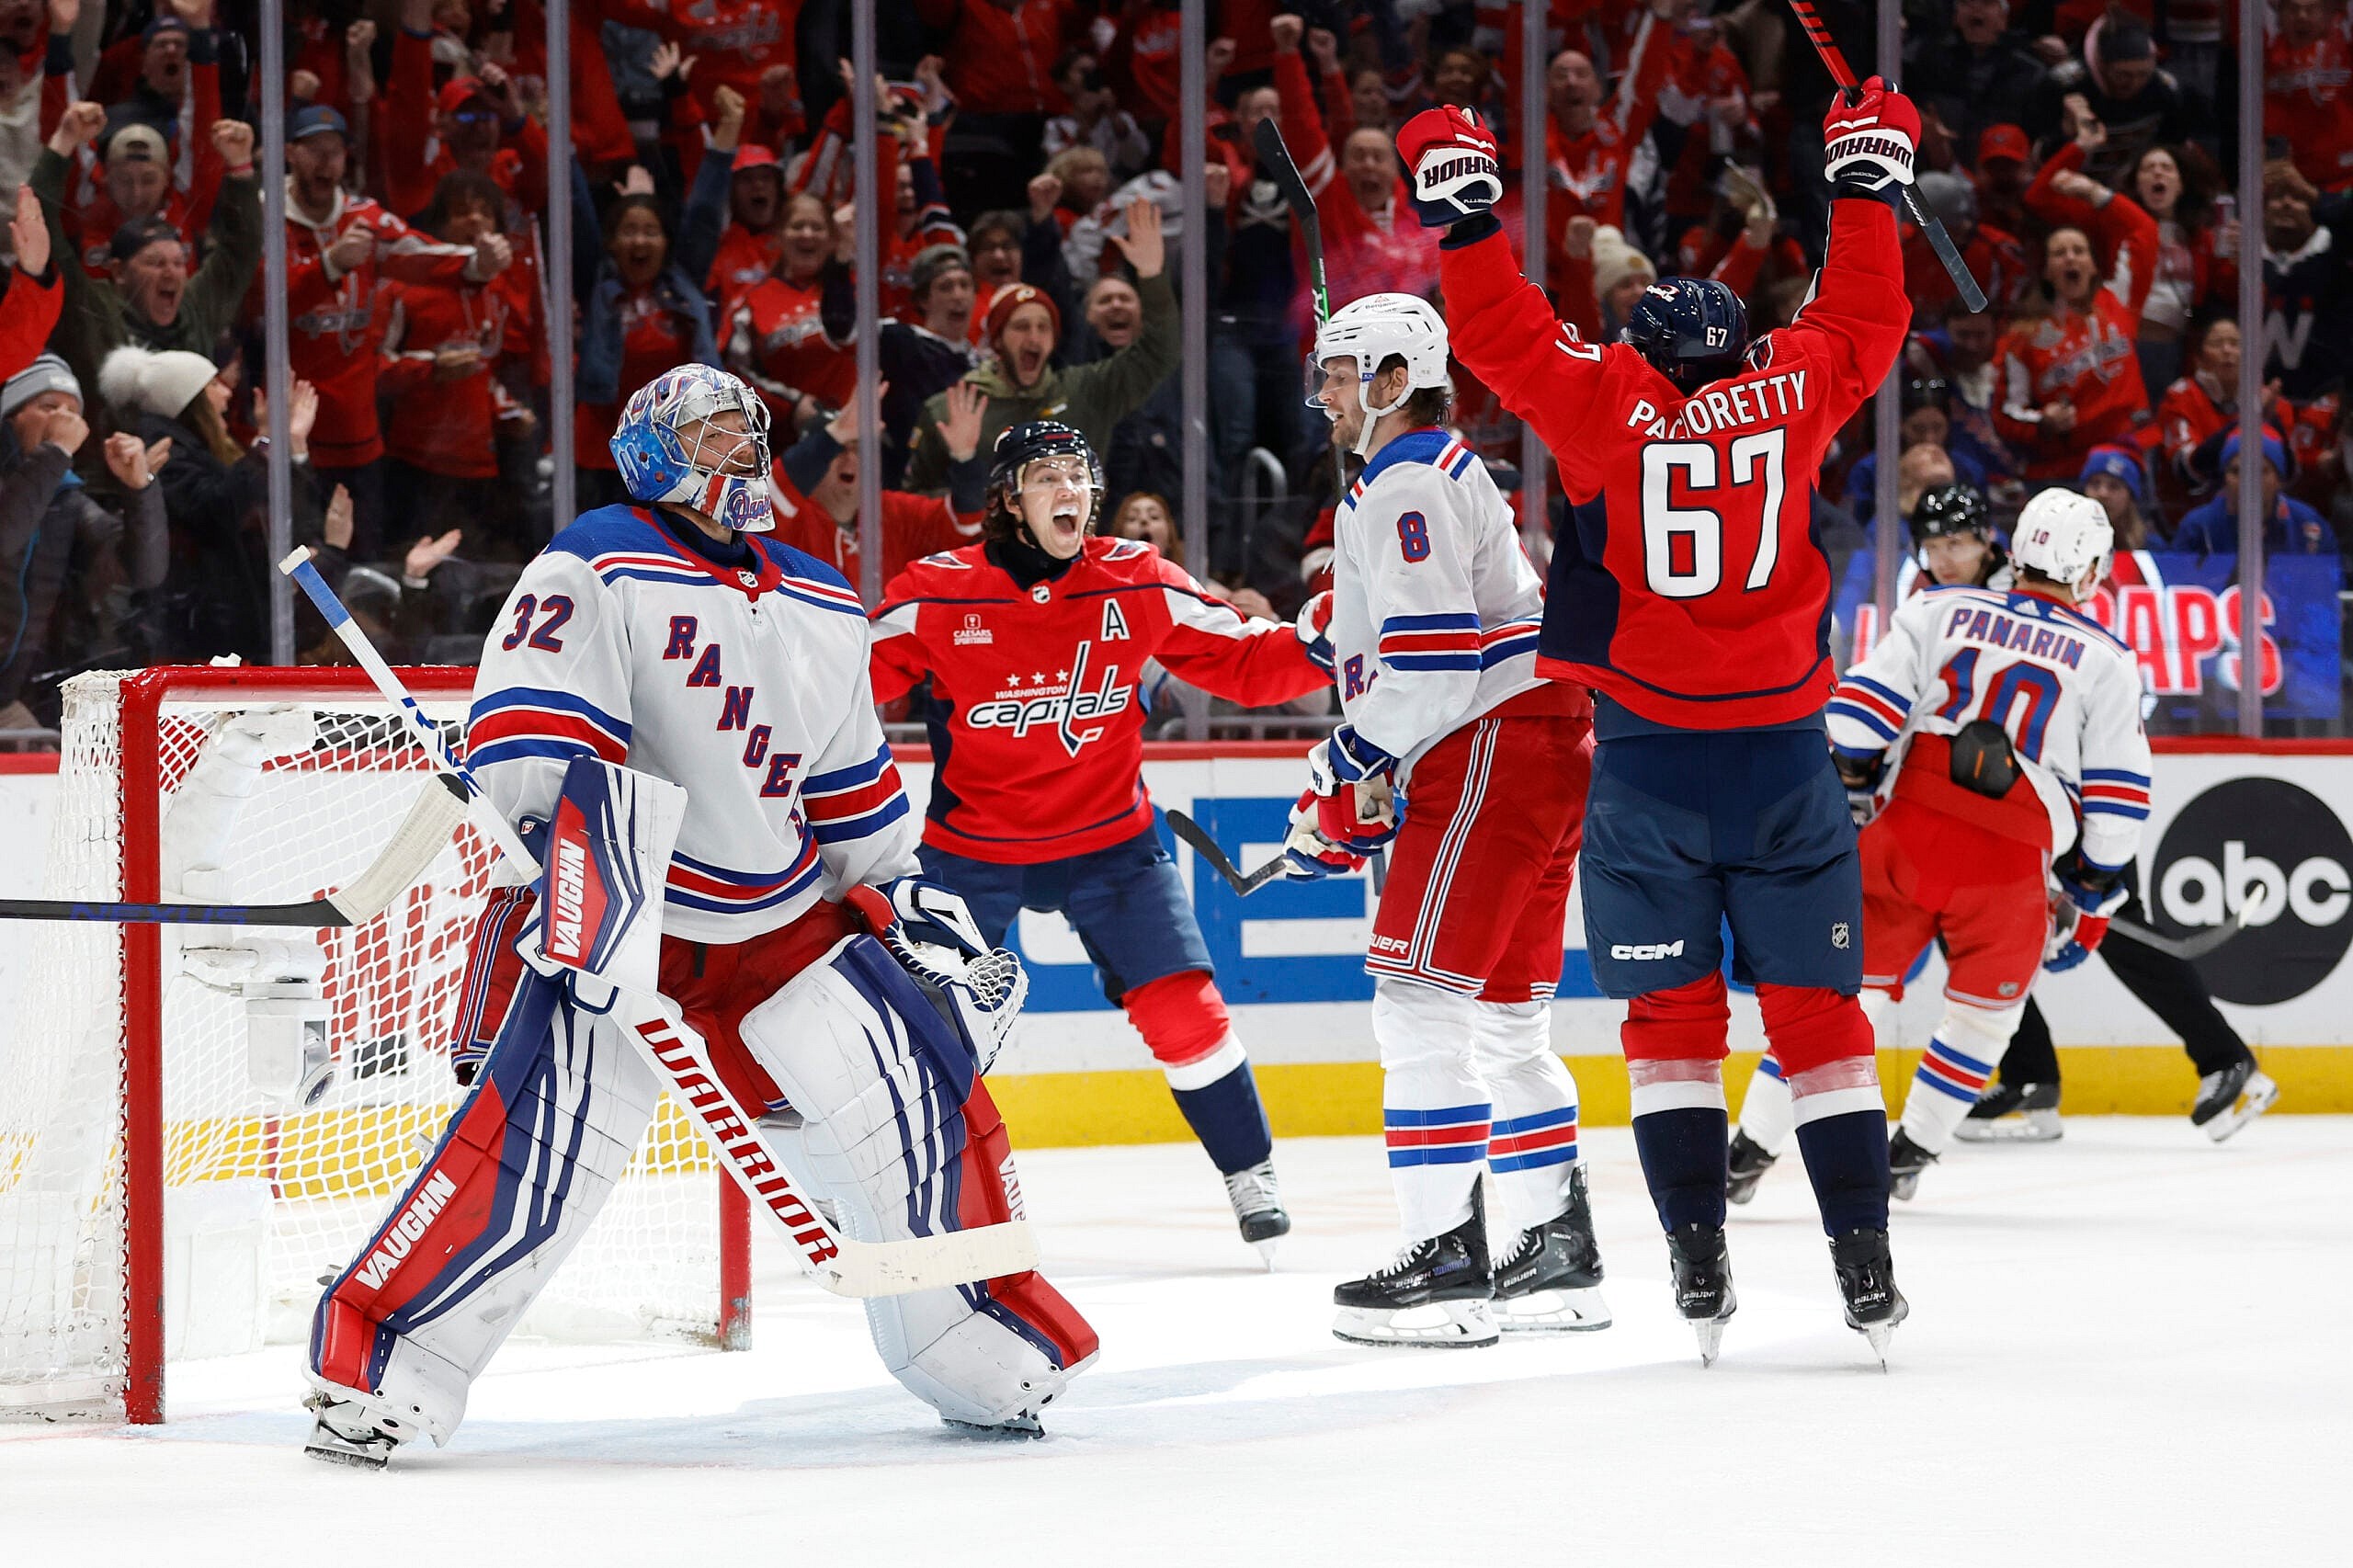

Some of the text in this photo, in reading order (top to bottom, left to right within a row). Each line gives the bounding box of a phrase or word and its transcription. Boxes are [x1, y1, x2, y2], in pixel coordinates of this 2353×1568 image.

[1423, 155, 1499, 189] RRIOR
[1825, 136, 1913, 170] WARRIO
[1706, 326, 1728, 347] 67
[1396, 510, 1431, 563] 8
[1641, 425, 1788, 600] 67
[2031, 528, 2050, 545] 10
[502, 593, 574, 653] 32
[953, 629, 993, 638] CAESARS
[1101, 597, 1131, 642] A
[1946, 608, 2086, 671] PANARIN
[995, 686, 1067, 699] WASHINGTON
[1934, 646, 2063, 764] 10
[553, 838, 585, 959] VAUGHN
[2161, 840, 2352, 927] abc
[69, 903, 248, 925] NEXUS
[1370, 933, 1409, 955] UER
[1610, 939, 1685, 960] CCM
[634, 1017, 839, 1267] WARRIOR
[998, 1152, 1026, 1221] VAUG
[355, 1169, 457, 1290] VAUGHN
